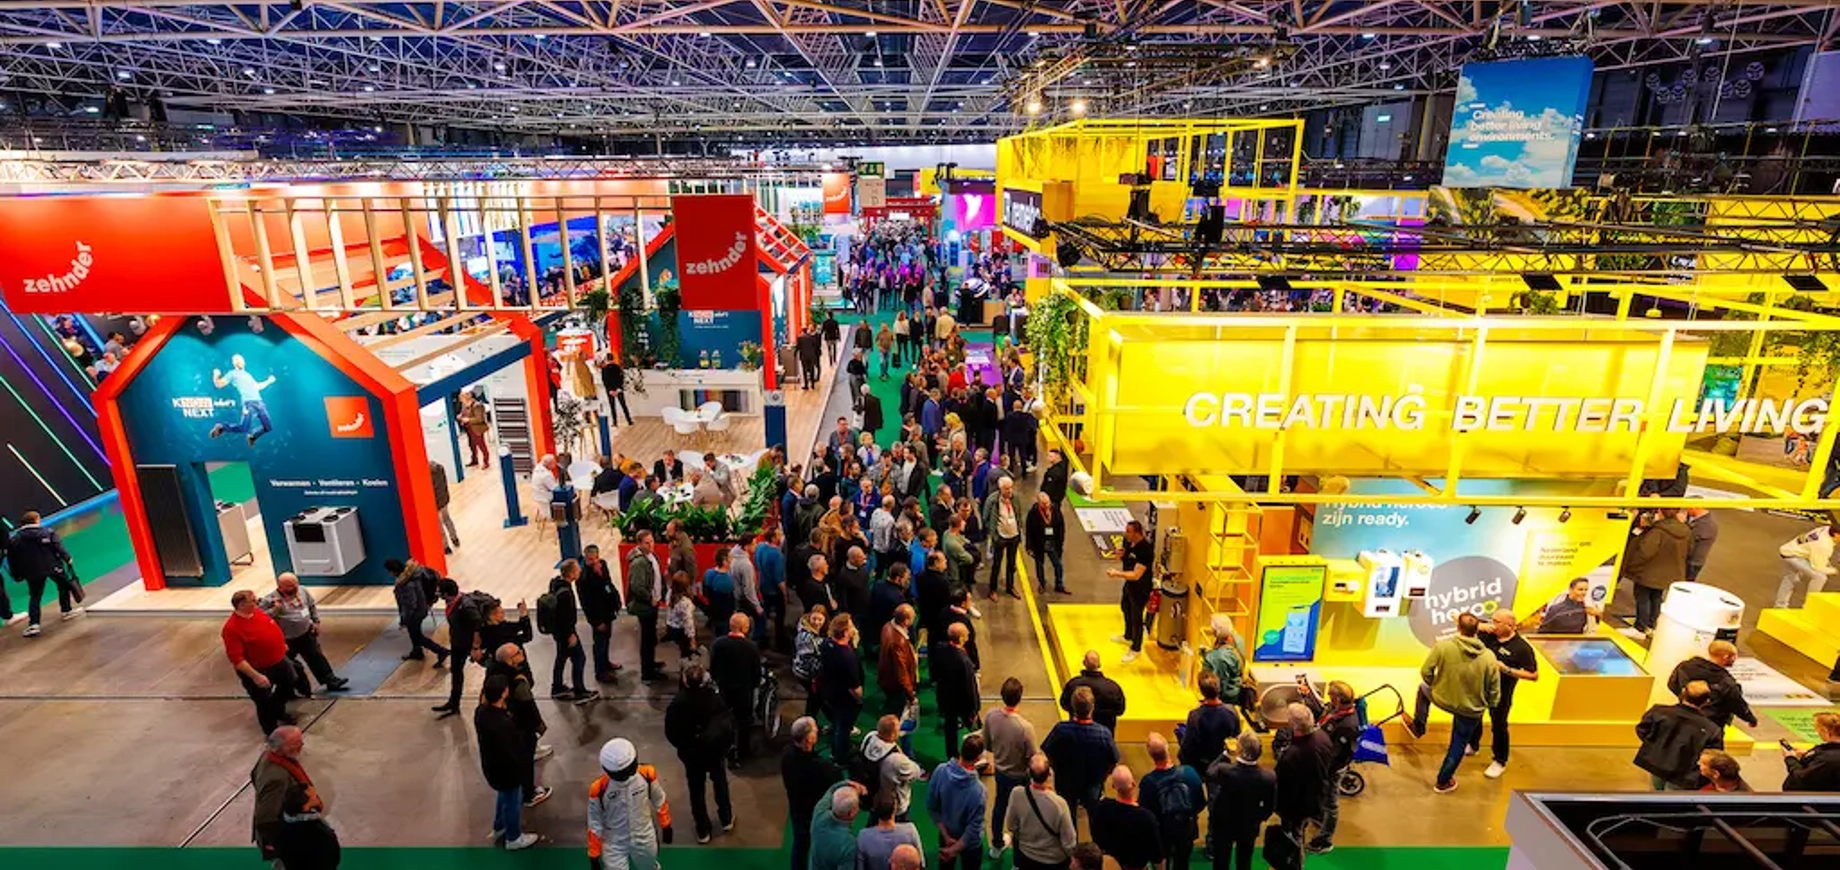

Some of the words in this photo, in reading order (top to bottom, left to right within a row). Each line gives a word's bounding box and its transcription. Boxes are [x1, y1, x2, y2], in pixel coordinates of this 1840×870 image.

[1471, 120, 1508, 131] better
[1509, 119, 1541, 132] living
[1473, 109, 1524, 121] Creating
[686, 231, 747, 275] zehnder
[22, 240, 93, 293] zehnder
[183, 408, 214, 418] NEXT
[1183, 391, 1428, 431] CREATING
[1452, 396, 1644, 433] BETTER
[1666, 397, 1829, 434] LIVING
[1321, 510, 1353, 528] zijn
[1358, 511, 1409, 528] ready.
[1425, 577, 1502, 609] hybrid
